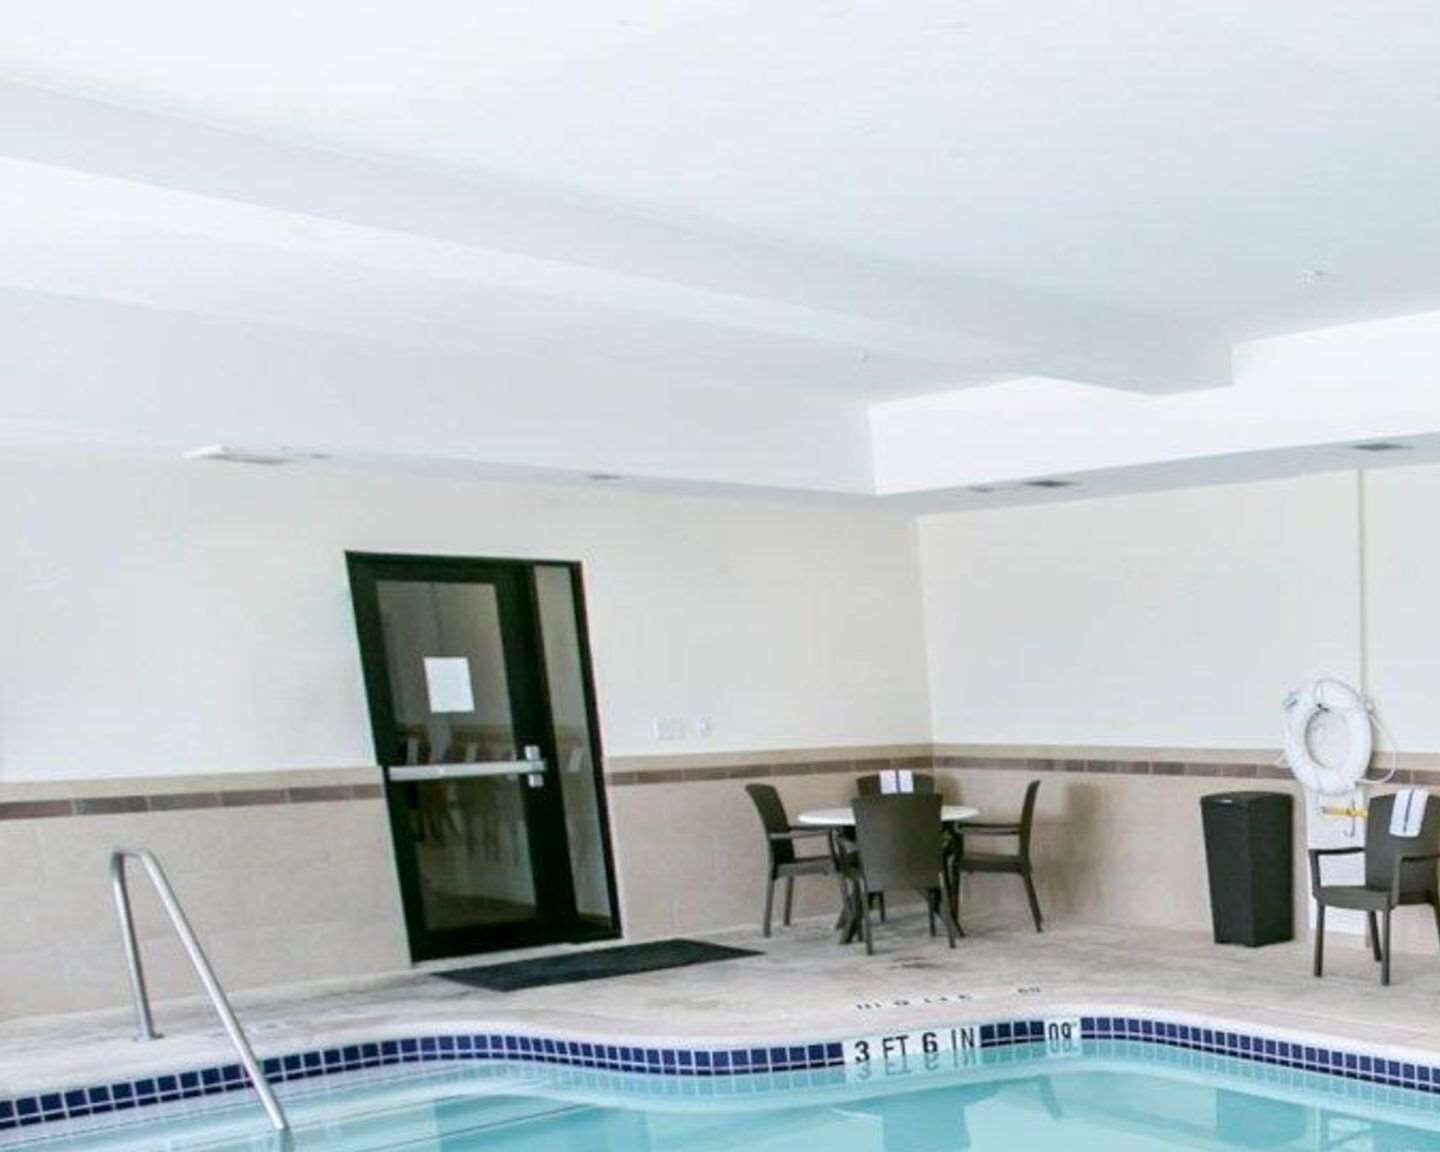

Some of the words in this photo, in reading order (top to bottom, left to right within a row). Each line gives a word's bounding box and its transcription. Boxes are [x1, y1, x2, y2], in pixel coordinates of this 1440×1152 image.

[854, 1039, 870, 1062] 3
[882, 1034, 908, 1060] FT
[922, 1031, 938, 1053] 6
[951, 1027, 975, 1050] IN
